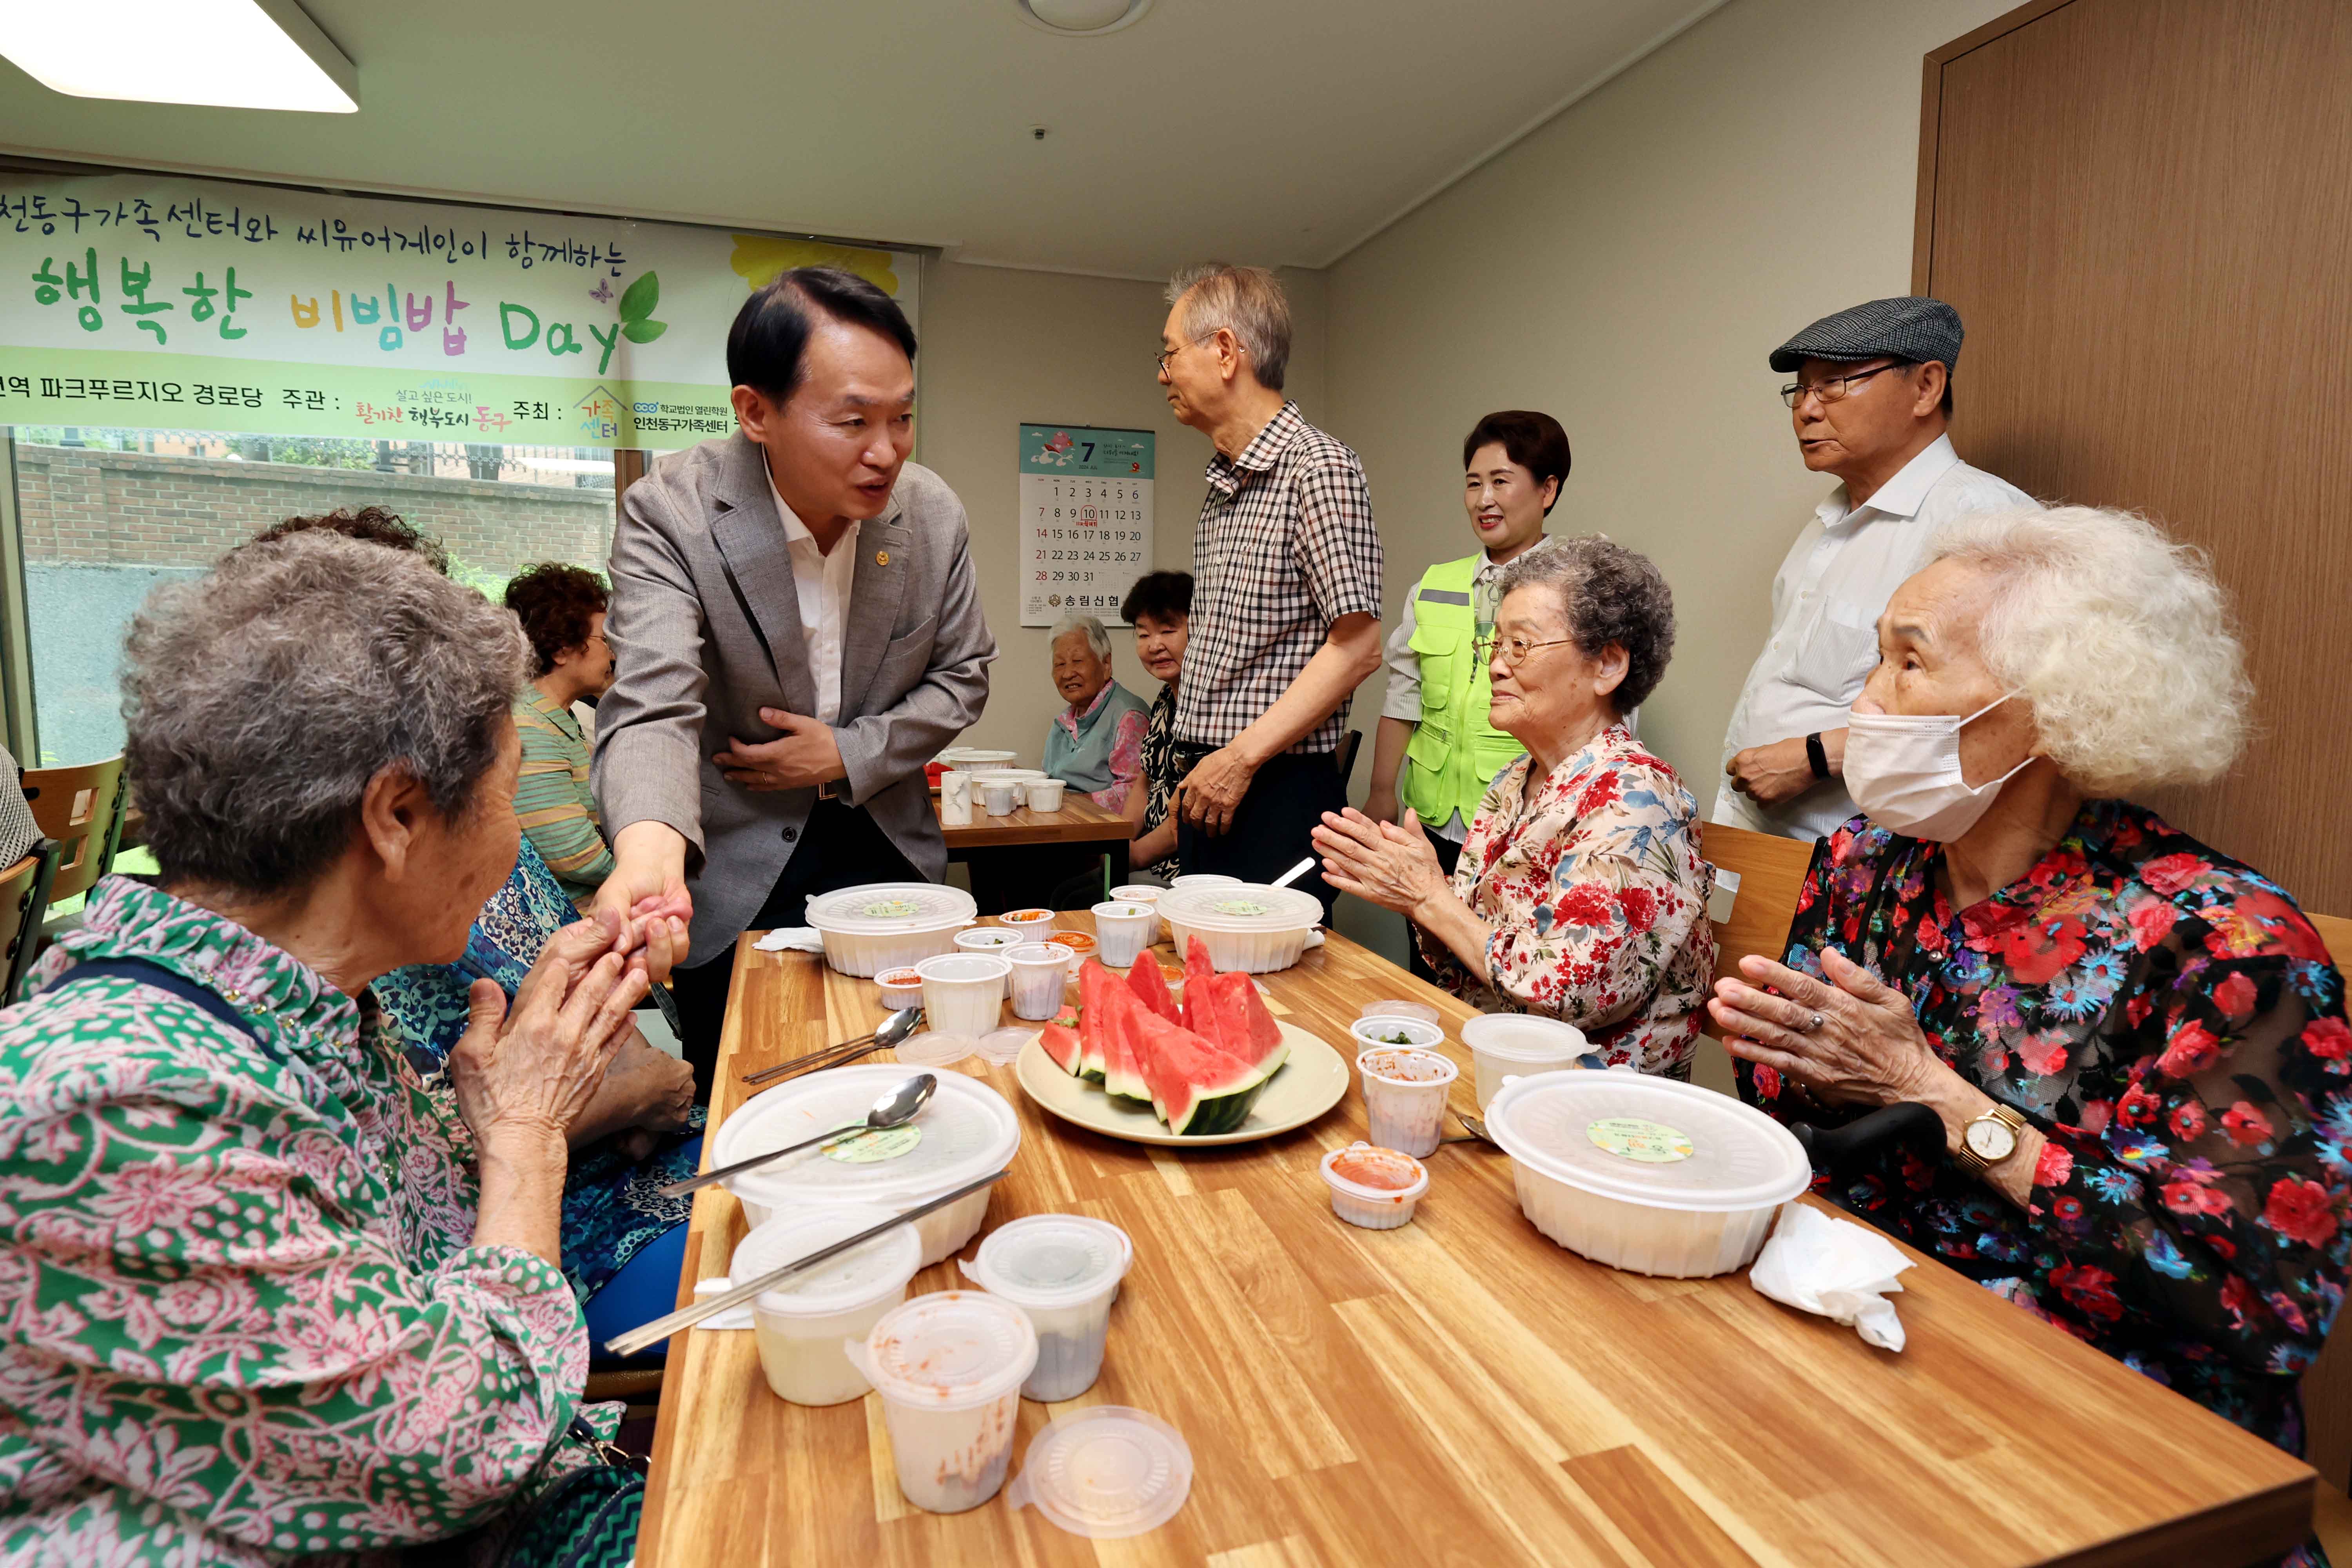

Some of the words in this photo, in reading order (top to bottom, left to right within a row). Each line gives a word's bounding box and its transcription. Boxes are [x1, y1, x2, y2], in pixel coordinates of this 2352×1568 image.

[298, 219, 486, 263] 씨유어게인이
[506, 230, 626, 277] 함께하는
[32, 247, 253, 345] 행복한
[291, 280, 471, 356] 비빔밥
[499, 301, 619, 375] Day
[40, 378, 184, 403] 파크푸르지오
[193, 383, 263, 408] 경로당
[282, 389, 326, 410] 주관
[396, 390, 419, 402] 살고
[422, 391, 443, 403] 싶은
[446, 392, 472, 405] 도시!
[356, 402, 404, 424] 활기찬
[408, 407, 469, 428] 행복도시
[472, 406, 513, 433] 동구
[513, 401, 549, 420] 주최
[582, 400, 615, 424] 가족
[660, 404, 693, 415] 학교법인
[695, 405, 728, 416] 열린학원
[580, 417, 617, 439] 센터
[633, 417, 728, 433] 인천동구가족센터
[1081, 442, 1095, 462] 7
[1054, 487, 1058, 496] 1
[1070, 488, 1075, 497] 2
[1085, 488, 1091, 497] 3
[1101, 489, 1107, 498] 4
[1117, 490, 1123, 499] 5
[1132, 490, 1138, 499] 6
[1039, 508, 1044, 516] 7
[1054, 508, 1060, 517] 8
[1071, 509, 1076, 517] 9
[1084, 509, 1094, 518] 10
[1100, 510, 1109, 519] 11
[1115, 511, 1125, 519] 12
[1131, 511, 1141, 520] 13
[1037, 529, 1047, 538] 14
[1052, 529, 1062, 539] 15
[1068, 530, 1078, 539] 16
[1084, 530, 1094, 539] 17
[1099, 531, 1110, 540] 18
[1115, 531, 1125, 540] 19
[1130, 532, 1141, 541] 20
[1036, 550, 1046, 559] 21
[1052, 550, 1063, 559] 22
[1068, 551, 1078, 560] 23
[1083, 551, 1094, 560] 24
[1099, 552, 1110, 561] 25
[1115, 552, 1126, 561] 26
[1130, 552, 1141, 561] 27
[1036, 571, 1047, 580] 28
[1053, 572, 1063, 581] 29
[1068, 572, 1079, 581] 30
[1083, 572, 1093, 581] 31
[1065, 595, 1119, 606] 송림신협
